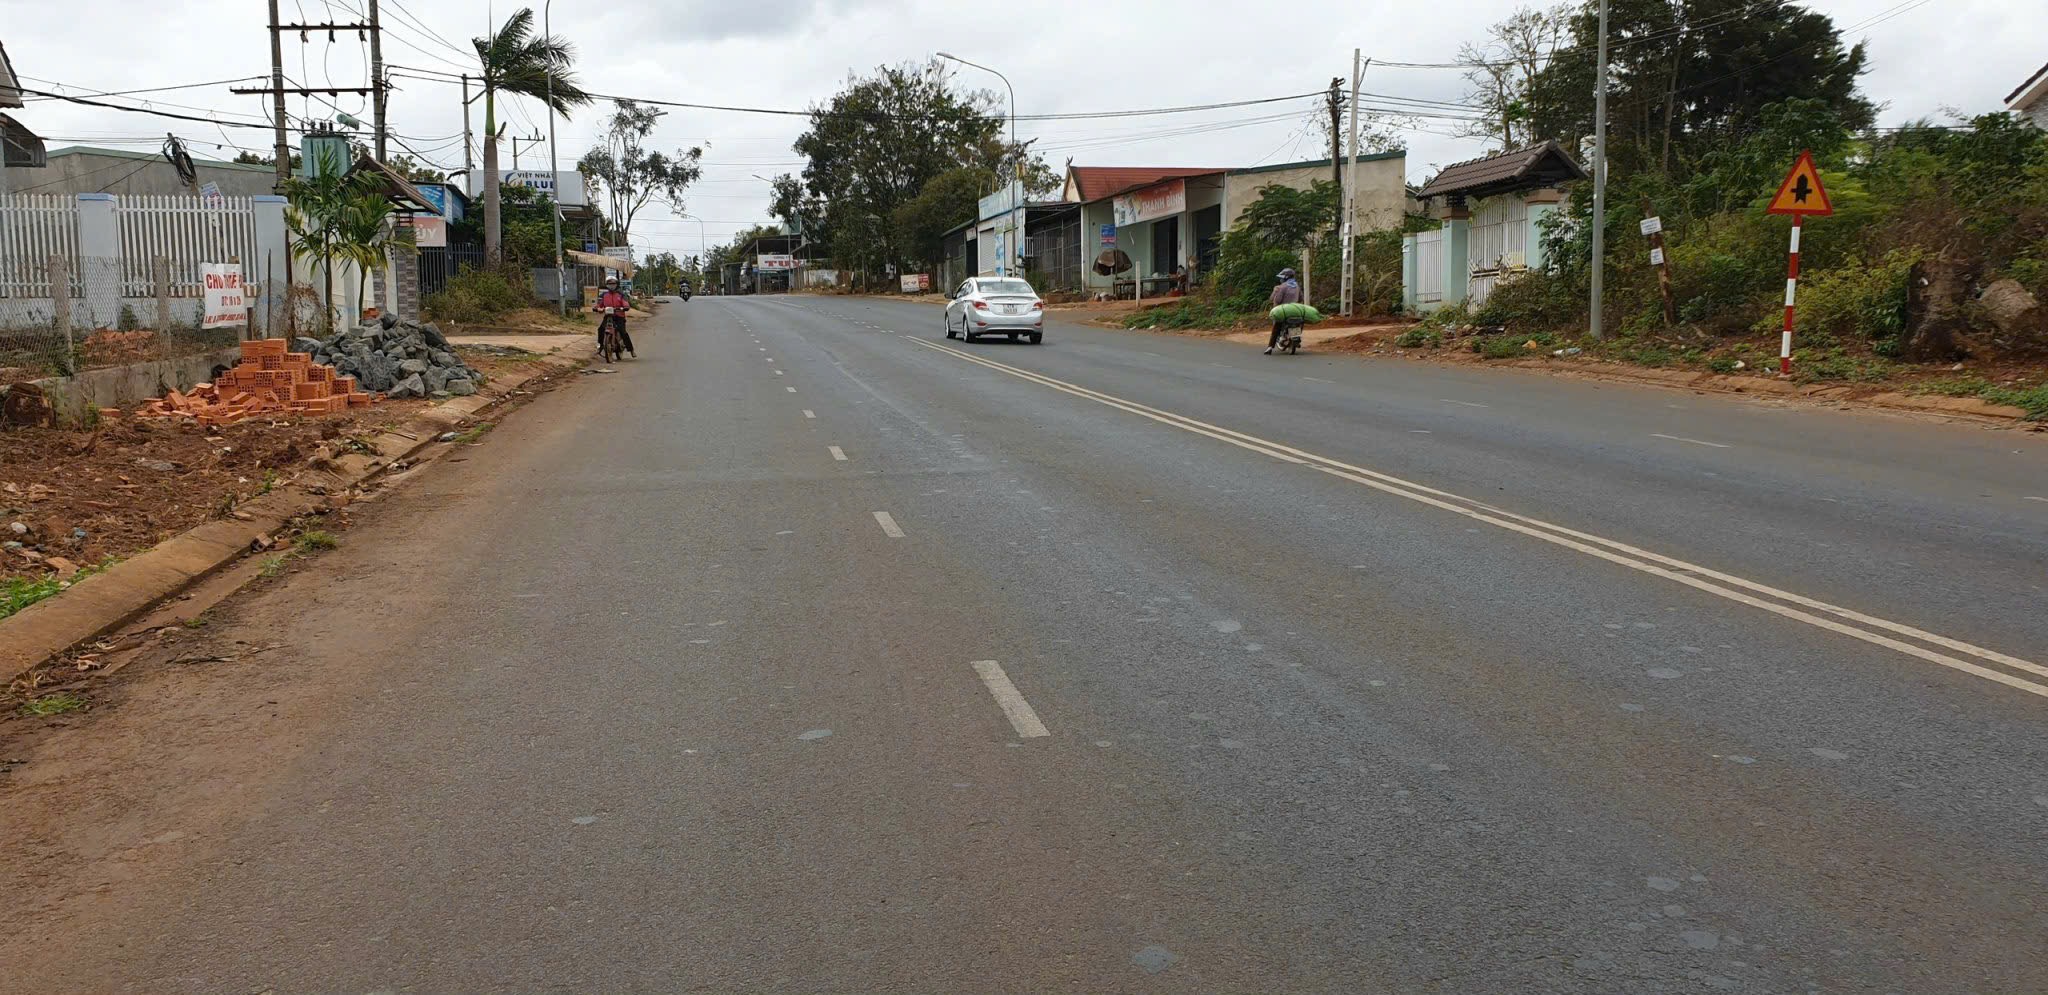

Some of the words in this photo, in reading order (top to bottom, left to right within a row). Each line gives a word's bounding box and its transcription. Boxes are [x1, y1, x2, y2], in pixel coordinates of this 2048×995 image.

[517, 171, 532, 179] VIỆT
[1141, 197, 1165, 215] THANH
[205, 273, 224, 289] CHO
